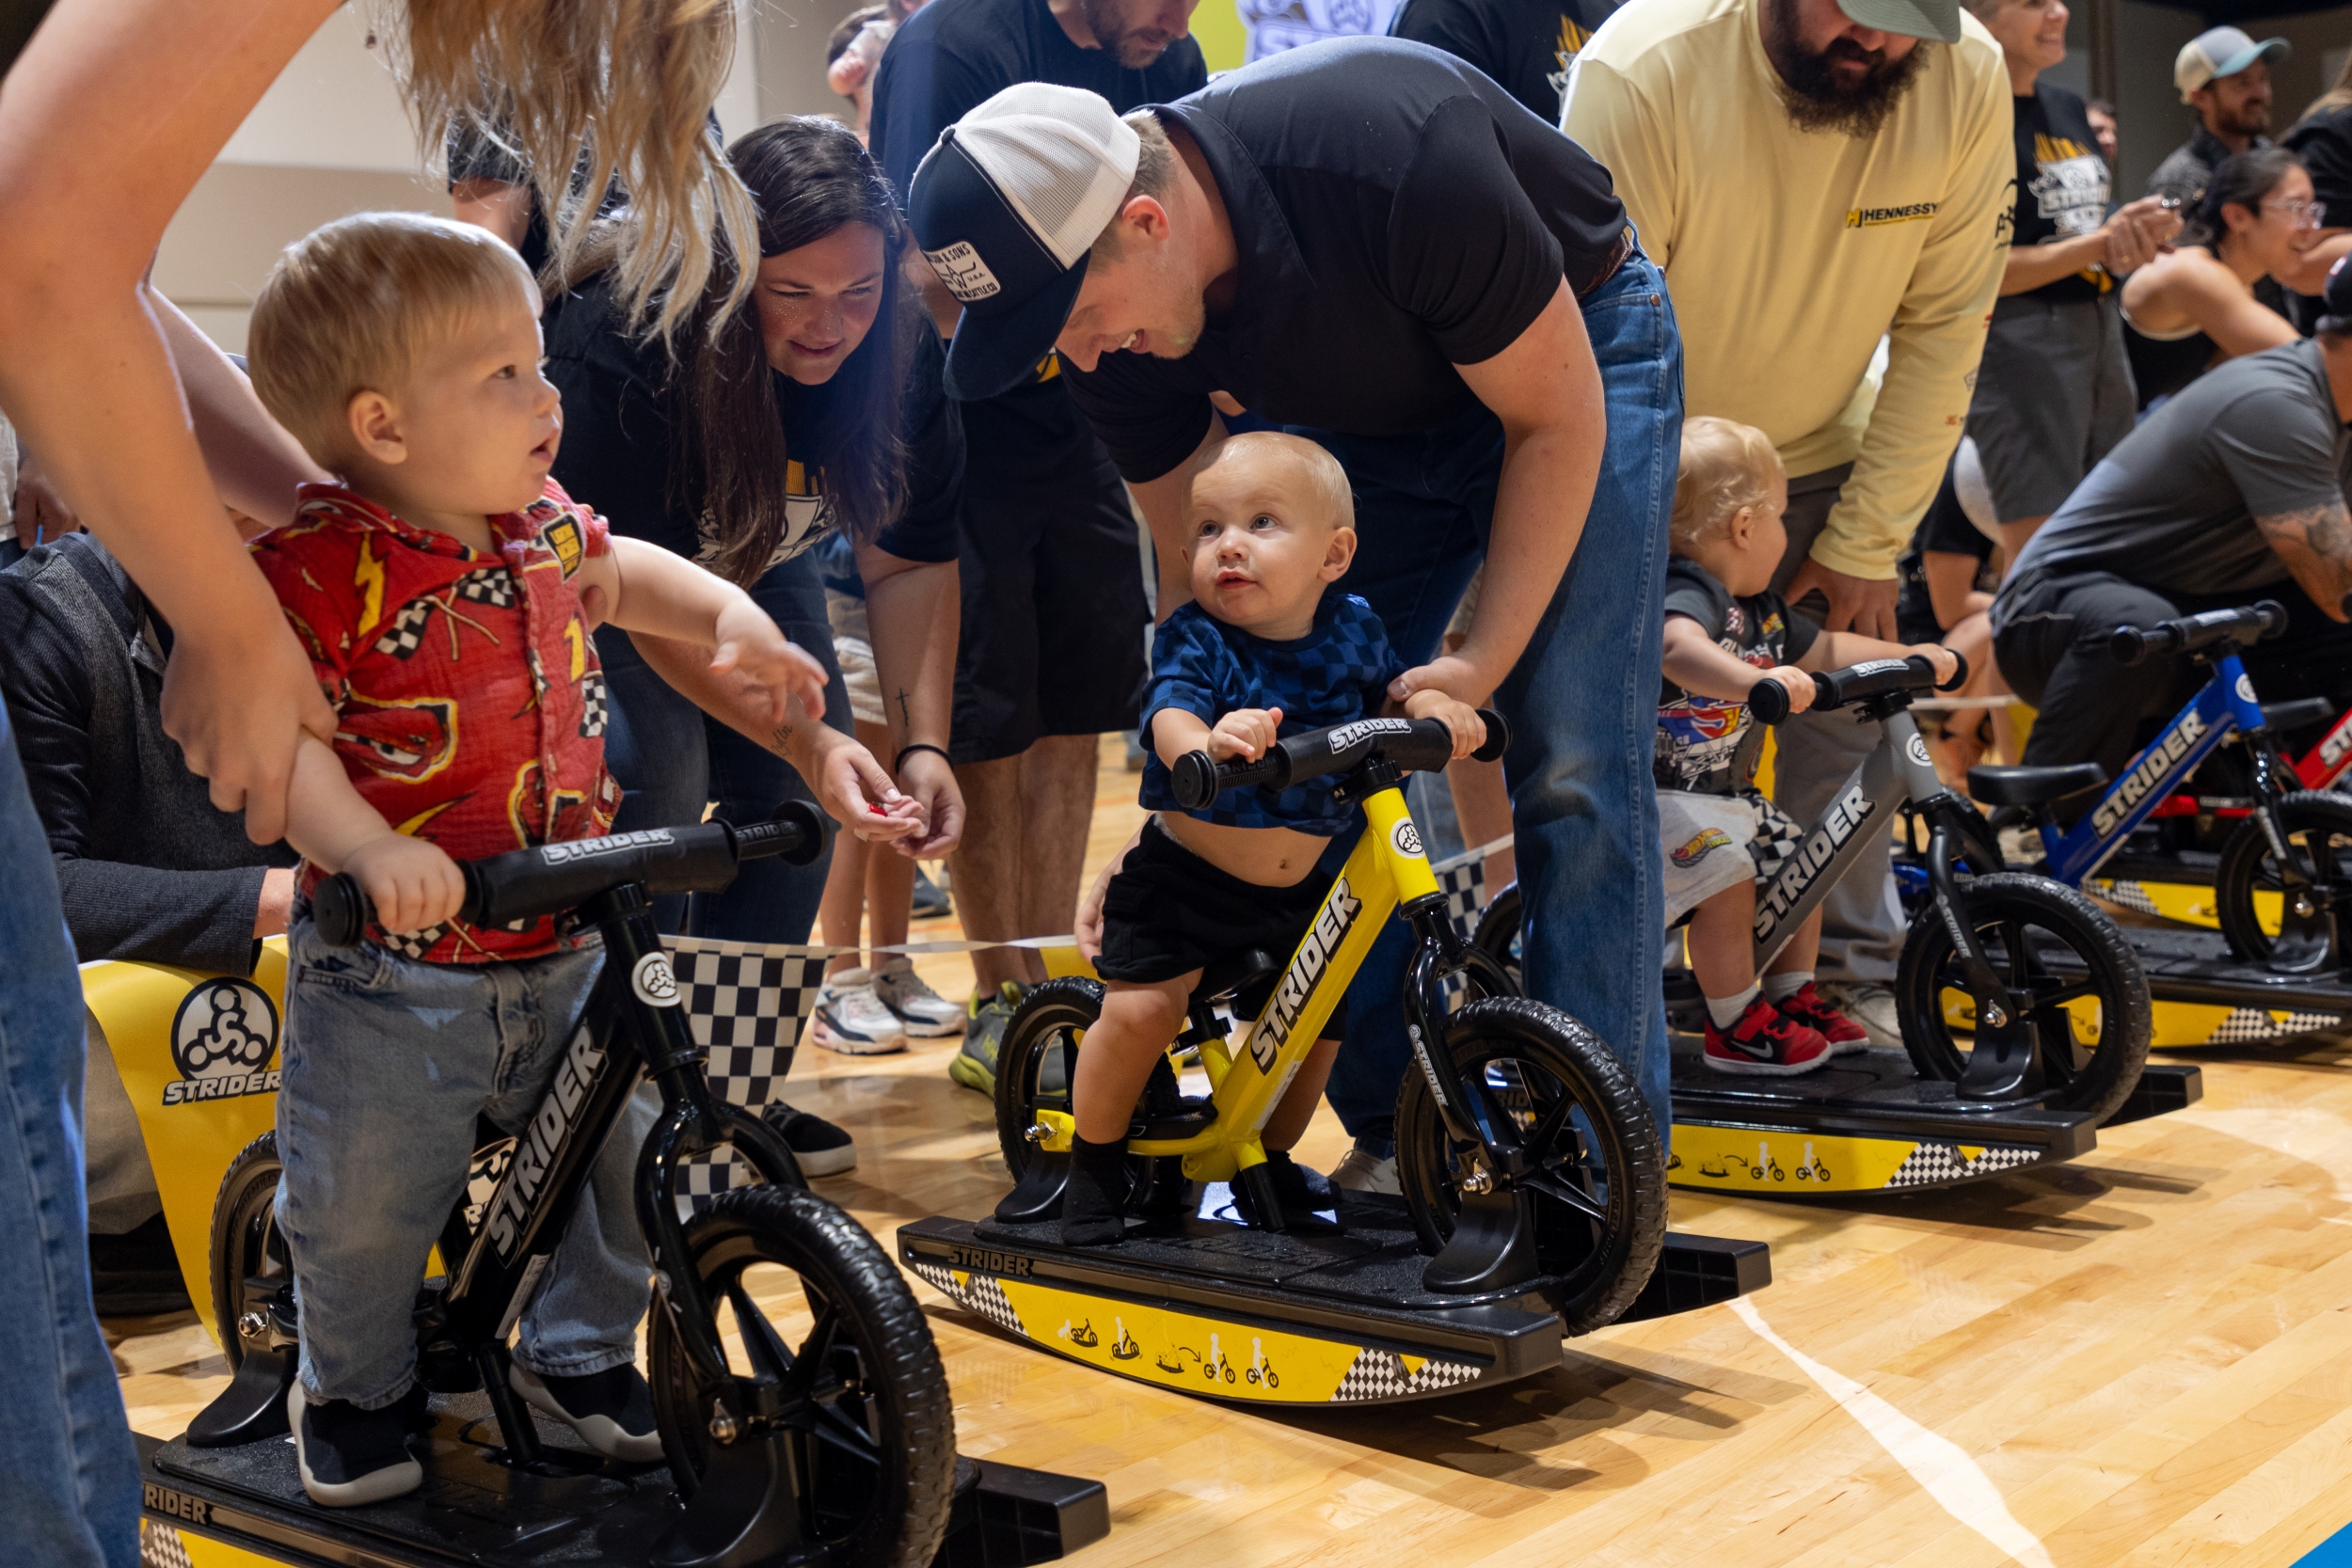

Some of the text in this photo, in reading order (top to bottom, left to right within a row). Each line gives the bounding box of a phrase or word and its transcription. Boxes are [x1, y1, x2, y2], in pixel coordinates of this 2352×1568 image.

[1864, 202, 1940, 222] HENNESSY
[948, 244, 971, 261] SONS
[1851, 659, 1909, 676] STRIDER
[1327, 718, 1412, 754] STRIDER
[2091, 708, 2208, 837] STRIDER
[541, 828, 675, 864] STRIDER
[735, 821, 797, 843] STRIDER
[1753, 784, 1875, 943] STRIDER
[1250, 877, 1362, 1076] STRIDER
[162, 1070, 281, 1106] STRIDER
[1413, 1039, 1449, 1106] STRIDER
[488, 1021, 607, 1262] STRIDER
[947, 1246, 1030, 1277] STRIDER
